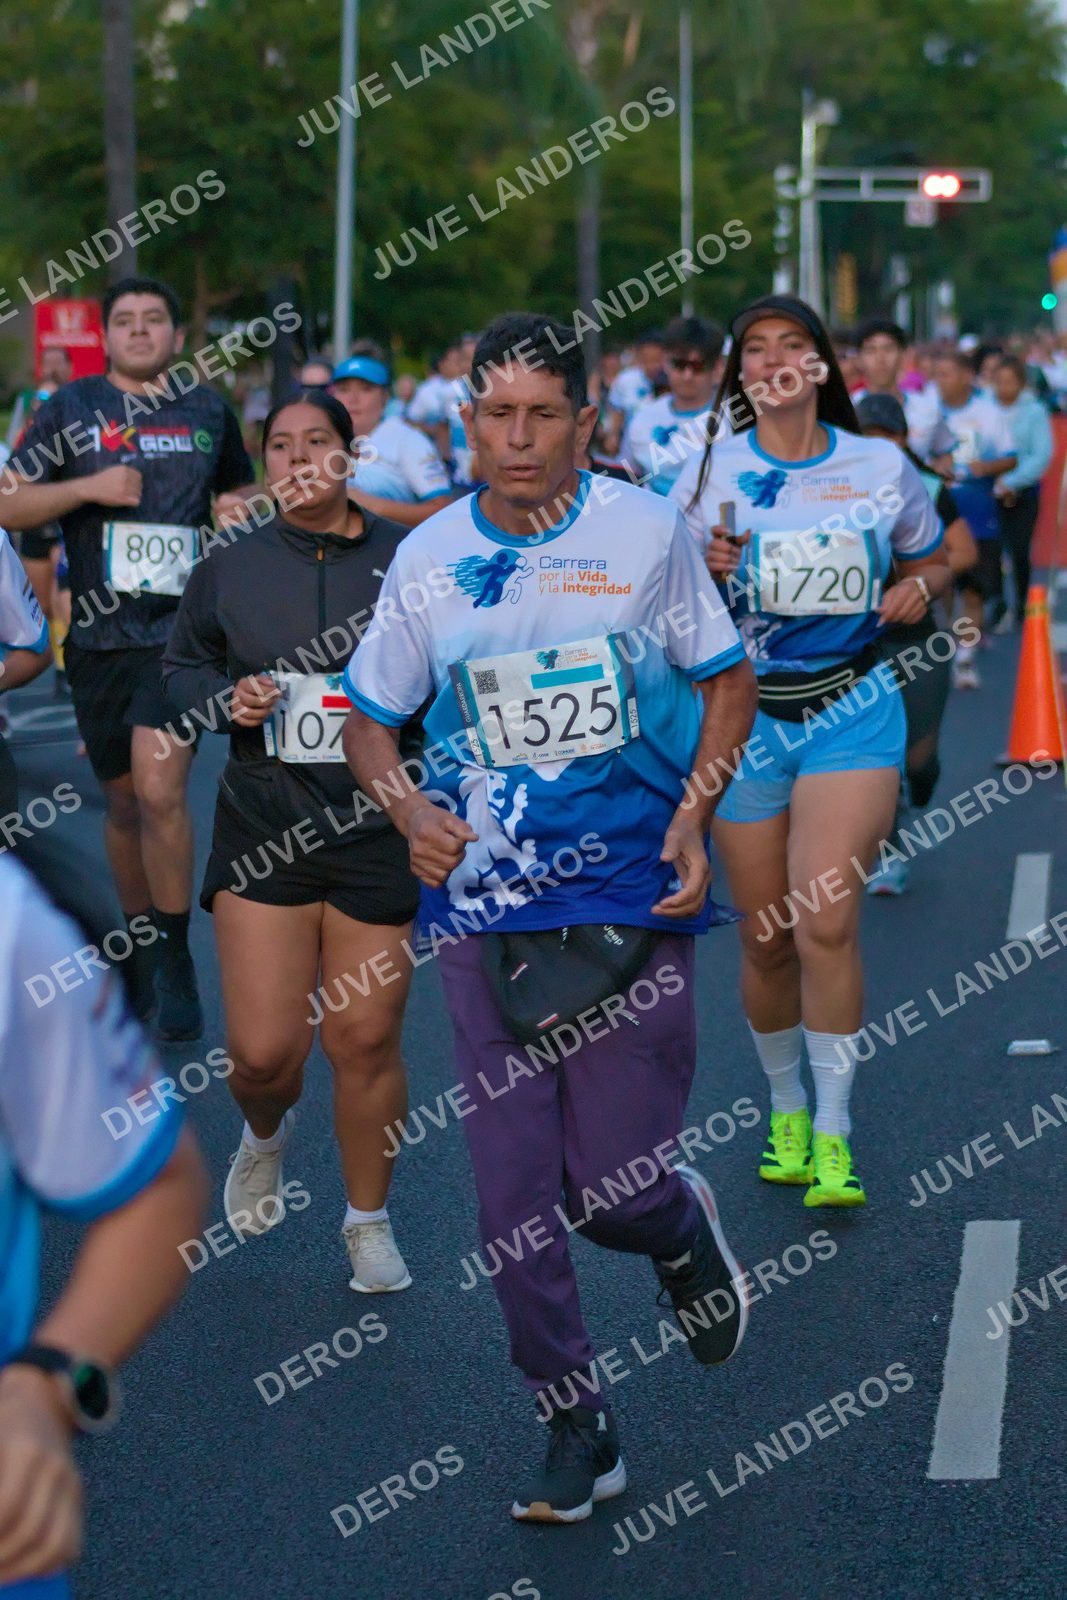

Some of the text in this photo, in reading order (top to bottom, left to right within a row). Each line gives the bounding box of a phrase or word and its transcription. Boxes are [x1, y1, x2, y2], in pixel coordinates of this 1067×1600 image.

[539, 555, 607, 570] Carrera
[539, 570, 607, 584] por la Vida
[769, 565, 866, 603] 1720
[538, 581, 631, 597] y la Integridad
[487, 684, 617, 750] 1525
